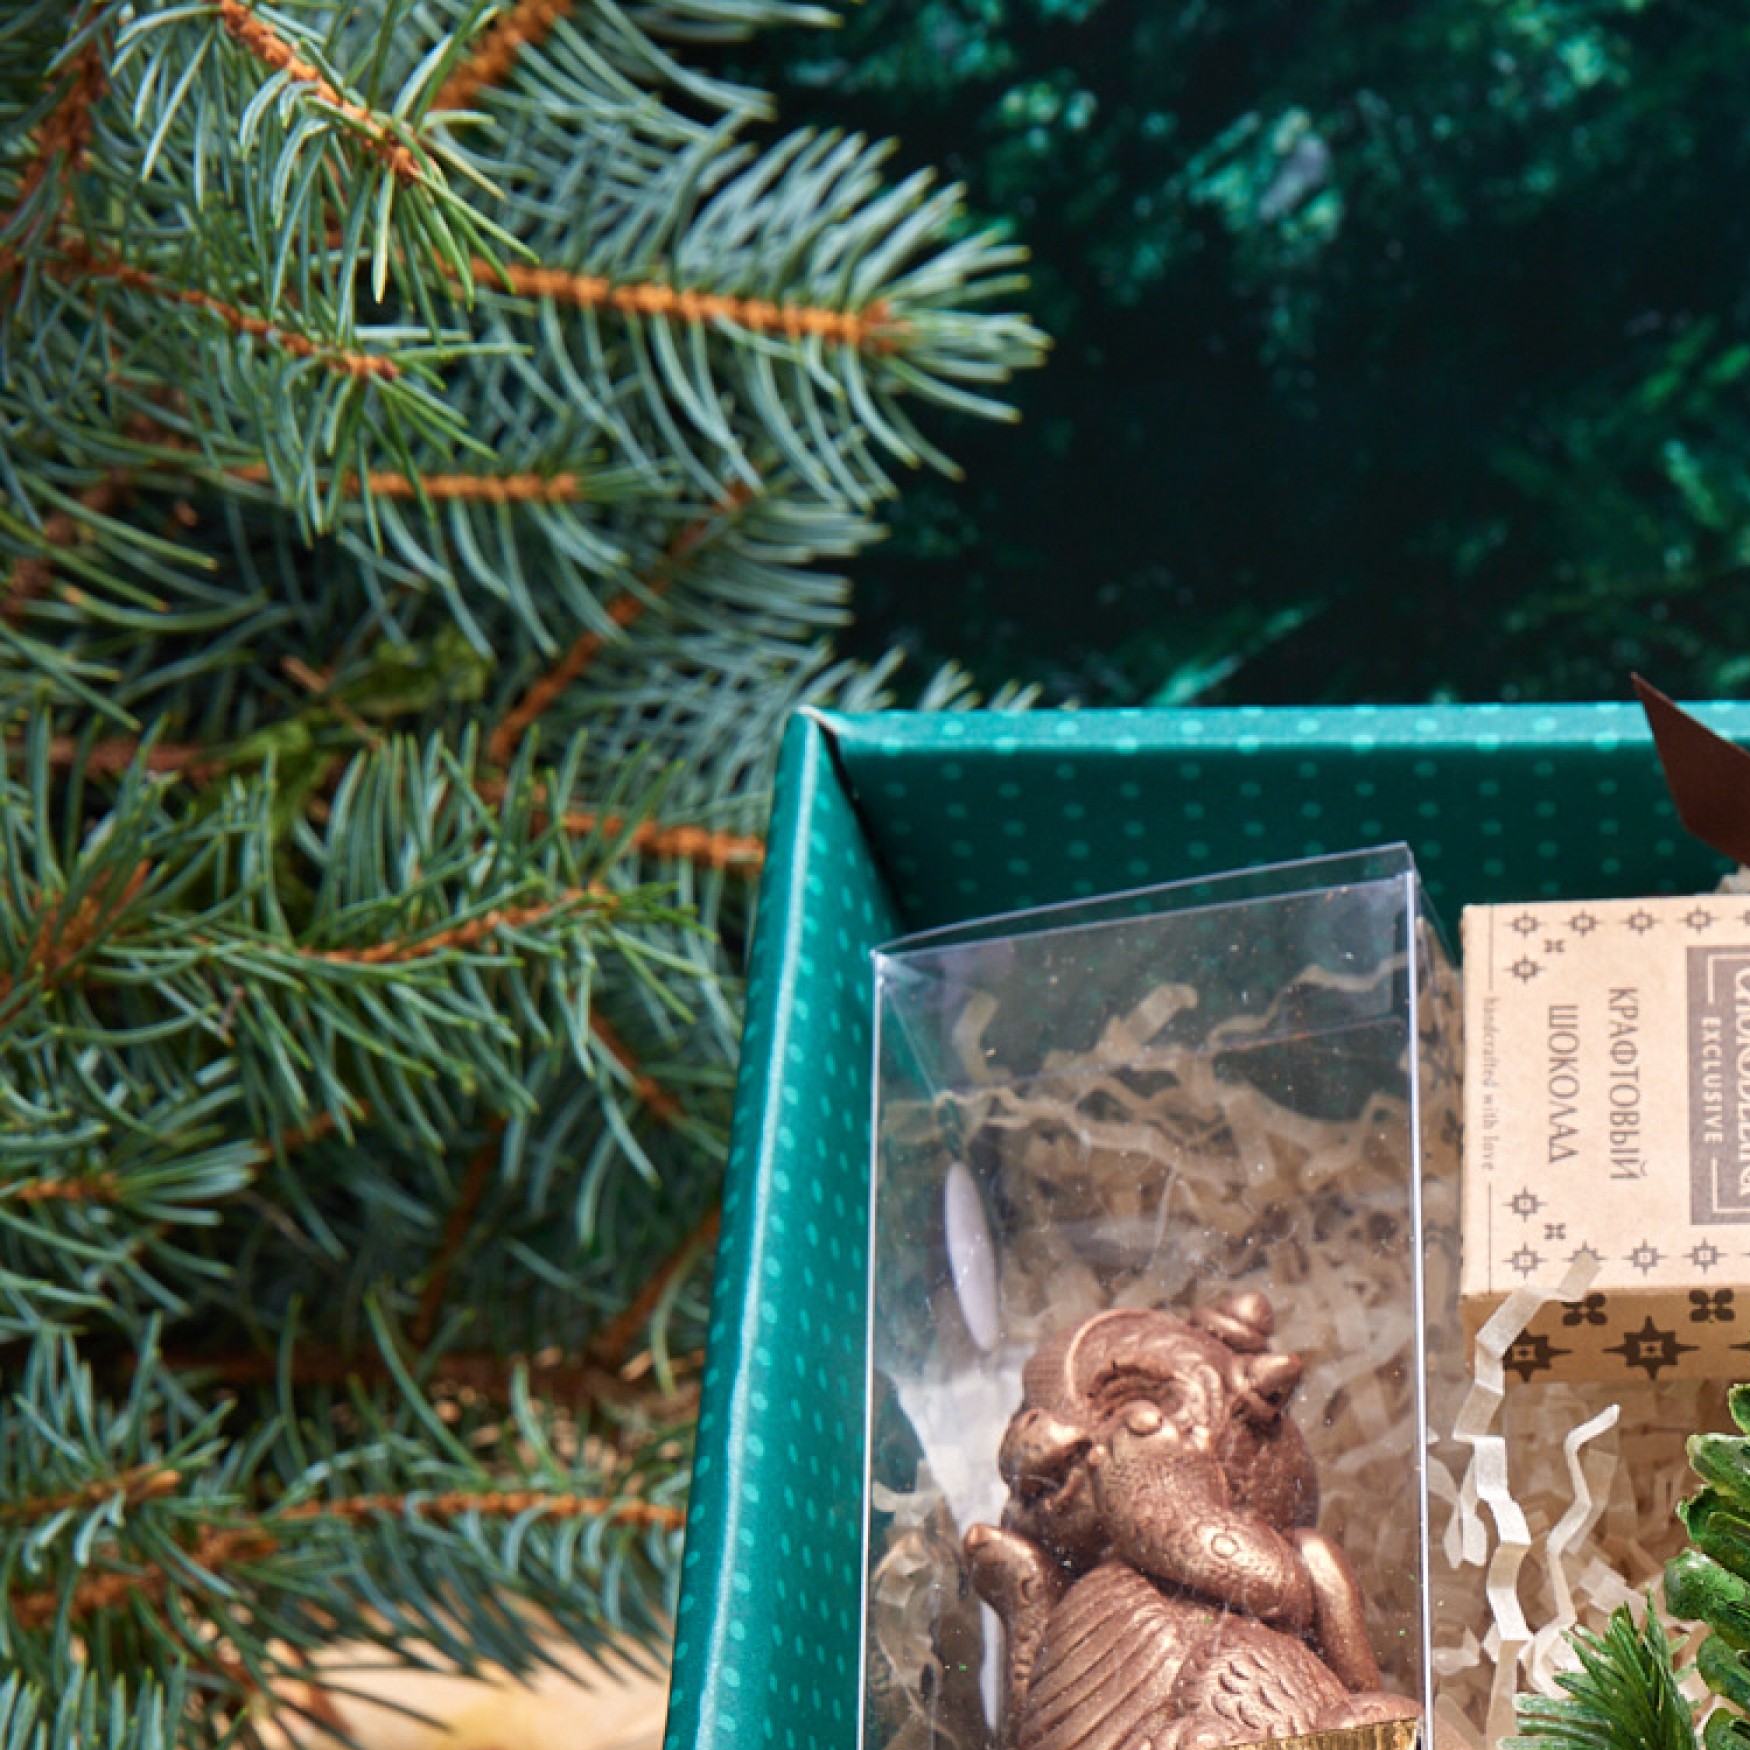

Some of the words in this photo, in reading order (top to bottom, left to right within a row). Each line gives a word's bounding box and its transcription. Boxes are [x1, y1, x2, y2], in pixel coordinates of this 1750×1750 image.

[1482, 996, 1500, 1087] handcrafted
[1547, 1003, 1582, 1165] ШОКОЛАД
[1607, 986, 1647, 1182] КРАФТОВЫЙ
[1700, 1016, 1724, 1144] EXCLUSIVE
[1481, 1136, 1500, 1170] love
[1482, 1093, 1500, 1130] with
